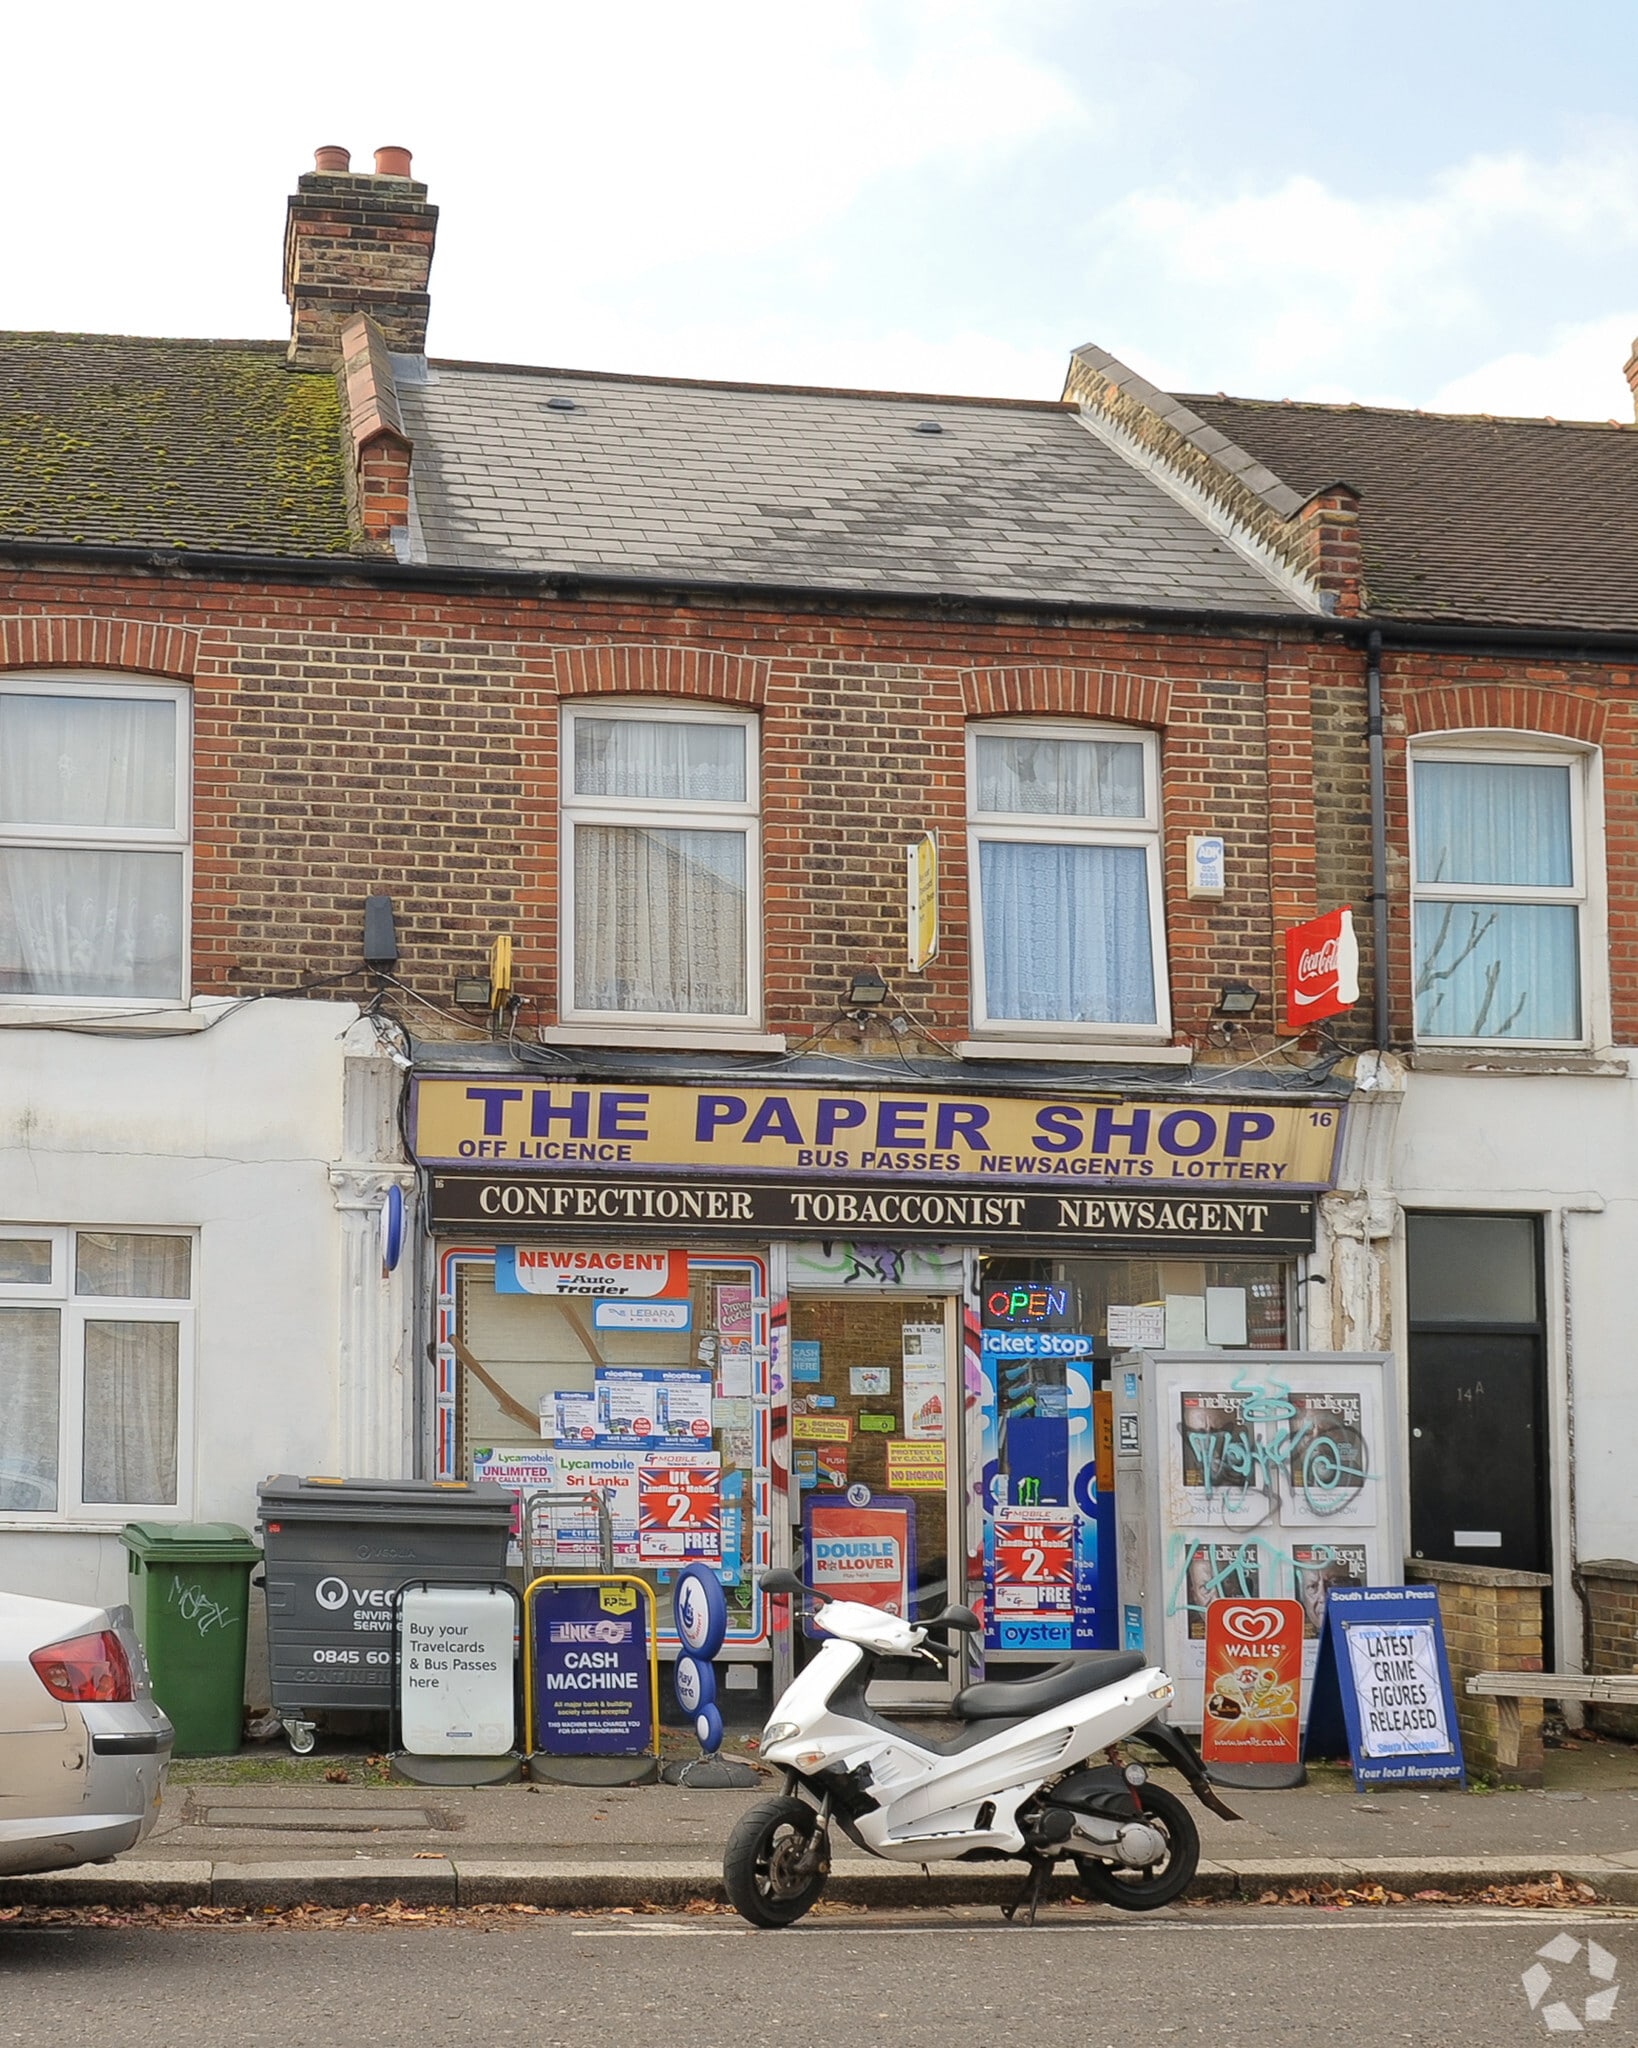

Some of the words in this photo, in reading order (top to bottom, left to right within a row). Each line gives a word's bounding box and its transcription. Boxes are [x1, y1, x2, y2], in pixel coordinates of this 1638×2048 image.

[466, 1087, 650, 1141] THE
[695, 1094, 991, 1151] PAPER
[1031, 1105, 1276, 1158] SHOP
[1308, 1112, 1333, 1128] 16
[457, 1139, 507, 1158] OFF
[519, 1141, 632, 1162] LICENCE
[797, 1149, 849, 1168] BUS
[861, 1152, 960, 1171] PASSES
[980, 1155, 1154, 1177] NEWSAGENTS
[1172, 1160, 1288, 1180] LOTTERY
[479, 1185, 754, 1220] CONFECTIONER
[791, 1193, 1026, 1226] TOBACCONIST
[1057, 1200, 1268, 1232] NEWSAGENT
[519, 1251, 666, 1271] NEWSAGENT
[570, 1274, 615, 1285] Auto
[556, 1284, 629, 1296] Trader
[987, 1289, 1067, 1317] OPEN
[630, 1308, 676, 1317] LEBARA
[982, 1333, 1036, 1354] icket
[1039, 1334, 1090, 1357] Stop
[792, 1348, 818, 1357] CASH
[812, 1420, 847, 1428] SCHOOL
[498, 1453, 554, 1463] Lycamobile
[560, 1458, 635, 1471] Lycamobile
[483, 1466, 548, 1476] UNLIMITED
[668, 1471, 691, 1485] UK
[891, 1470, 905, 1481] NO
[529, 1476, 552, 1484] TEXTS
[566, 1475, 585, 1486] Sri
[589, 1475, 630, 1487] Lanka
[667, 1493, 691, 1528] 2
[1023, 1525, 1045, 1540] UK
[684, 1532, 719, 1549] FREE
[816, 1542, 893, 1558] DOUBLE
[817, 1558, 894, 1572] ROLLOVER
[1021, 1548, 1045, 1582] 2
[1038, 1586, 1072, 1602] FREE
[1331, 1591, 1363, 1601] South
[1364, 1591, 1403, 1600] London
[1405, 1590, 1436, 1600] Press
[1074, 1606, 1096, 1614] Tram
[353, 1620, 403, 1631] SERVIE
[410, 1623, 434, 1637] Buy
[439, 1625, 469, 1638] your
[1076, 1628, 1094, 1637] DLR
[1004, 1623, 1071, 1646] oyster
[409, 1640, 485, 1653] Travelcards
[1225, 1644, 1282, 1658] WALL'S
[1366, 1635, 1414, 1657] LATEST
[313, 1650, 360, 1664] 0845
[564, 1652, 619, 1669] CASH
[409, 1658, 420, 1670] &
[424, 1658, 448, 1671] Bus
[453, 1658, 497, 1671] Passes
[1374, 1660, 1417, 1682] CRIME
[409, 1676, 440, 1688] here
[547, 1672, 639, 1690] MACHINE
[1371, 1684, 1427, 1708] FIGURES
[1369, 1708, 1437, 1732] RELEASED
[1358, 1768, 1381, 1779] Your
[1382, 1766, 1406, 1778] local
[1407, 1765, 1461, 1779] Newspaper
